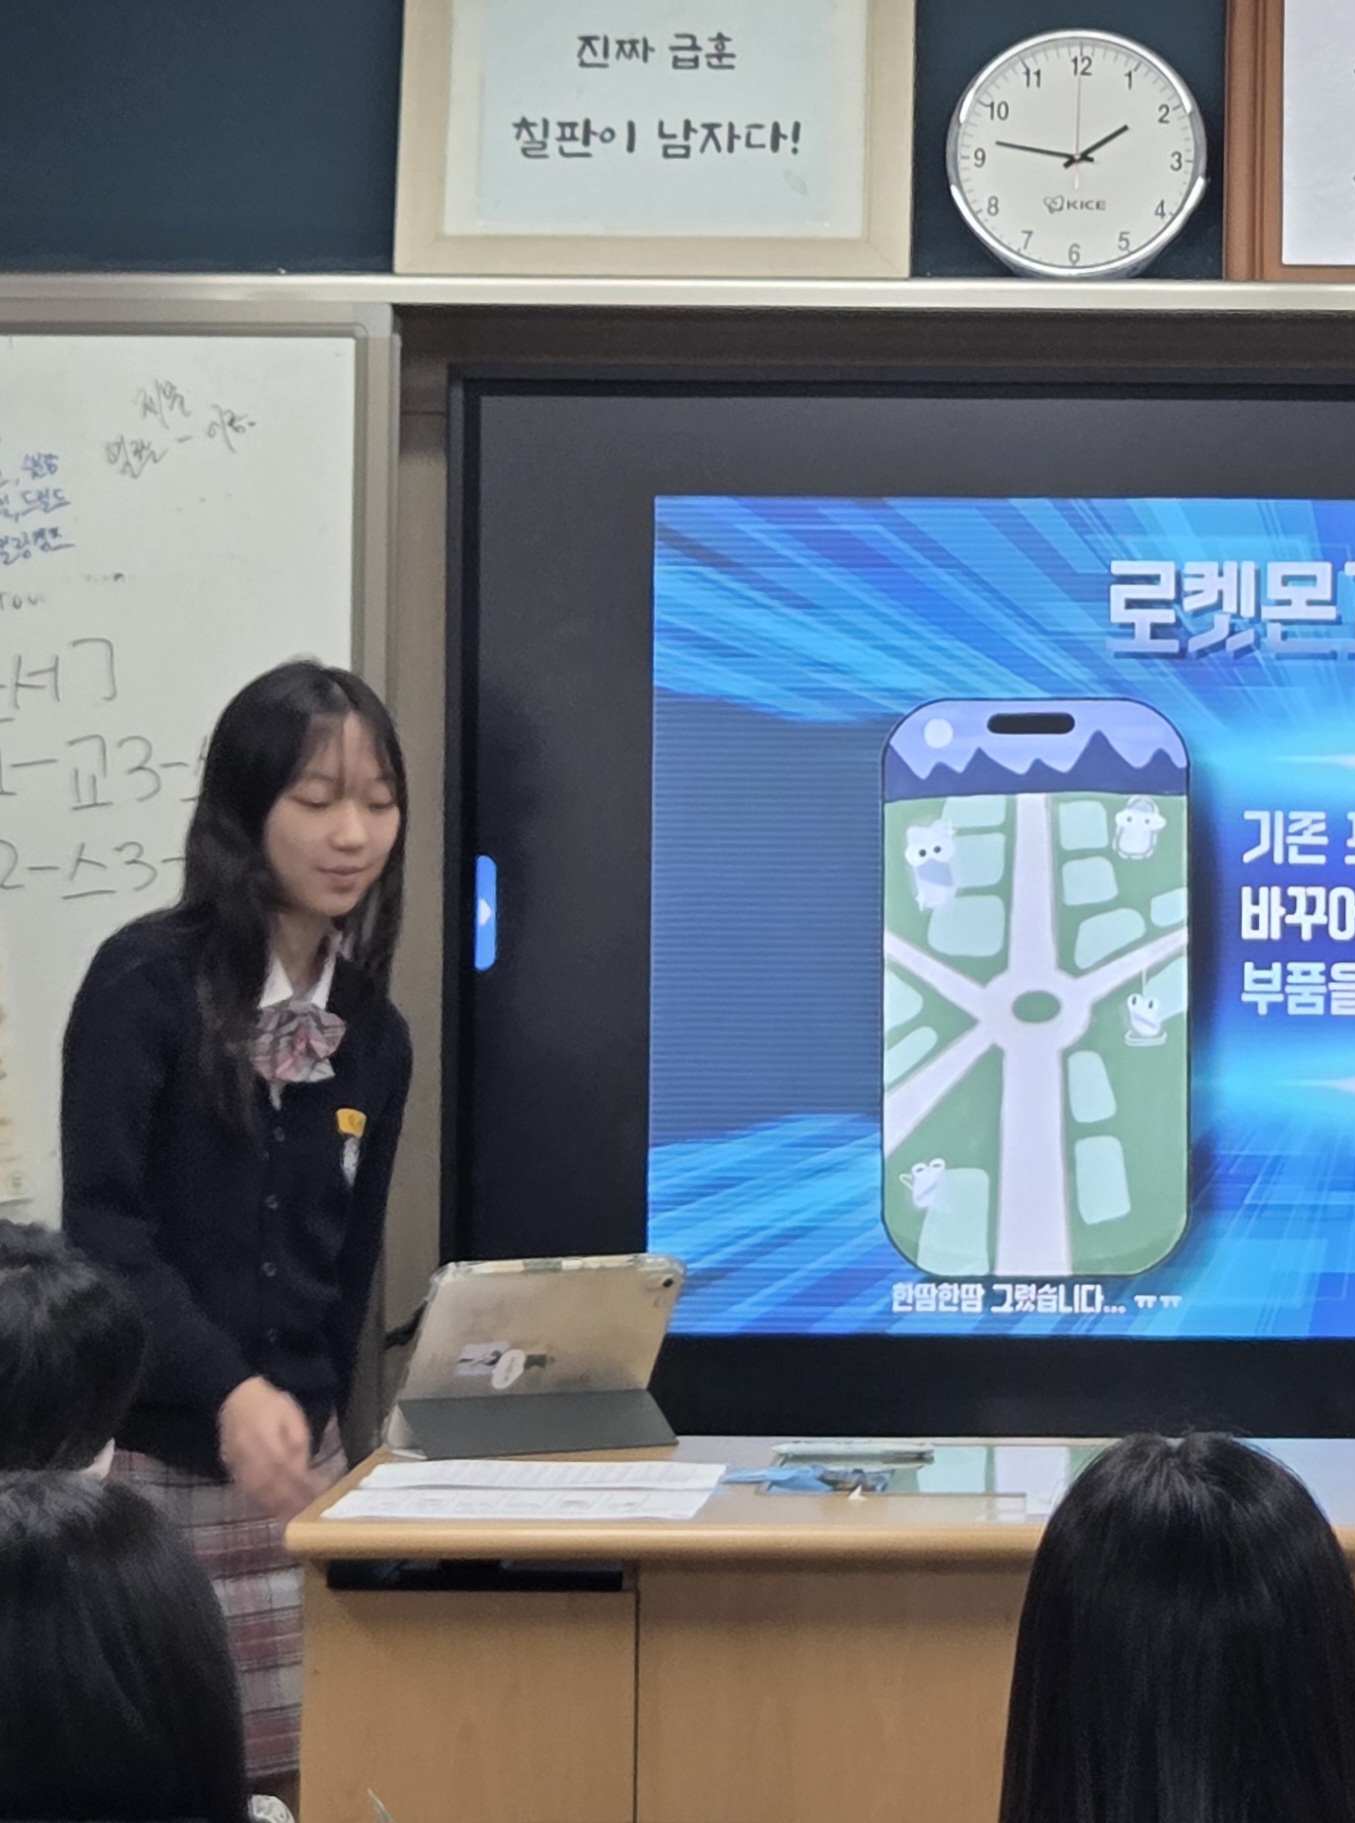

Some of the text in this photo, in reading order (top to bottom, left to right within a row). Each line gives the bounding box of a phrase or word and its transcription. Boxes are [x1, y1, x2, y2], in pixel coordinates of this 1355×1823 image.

[576, 32, 737, 71] 진짜 급훈
[1071, 55, 1093, 77] 12
[1024, 69, 1042, 88] 11
[1124, 70, 1133, 90] 1
[987, 100, 1009, 121] 10
[1157, 104, 1171, 124] 2
[512, 115, 802, 160] 칠판이 남자다!
[974, 147, 986, 168] 9
[1170, 151, 1183, 172] 3
[986, 196, 999, 217] 8
[1066, 199, 1106, 211] KICE
[1154, 199, 1167, 220] 4
[1021, 230, 1034, 250] 7
[1117, 231, 1130, 251] 5
[1067, 243, 1081, 264] 6
[1242, 809, 1329, 866] 기존
[891, 1282, 985, 1314] 한땀한땀
